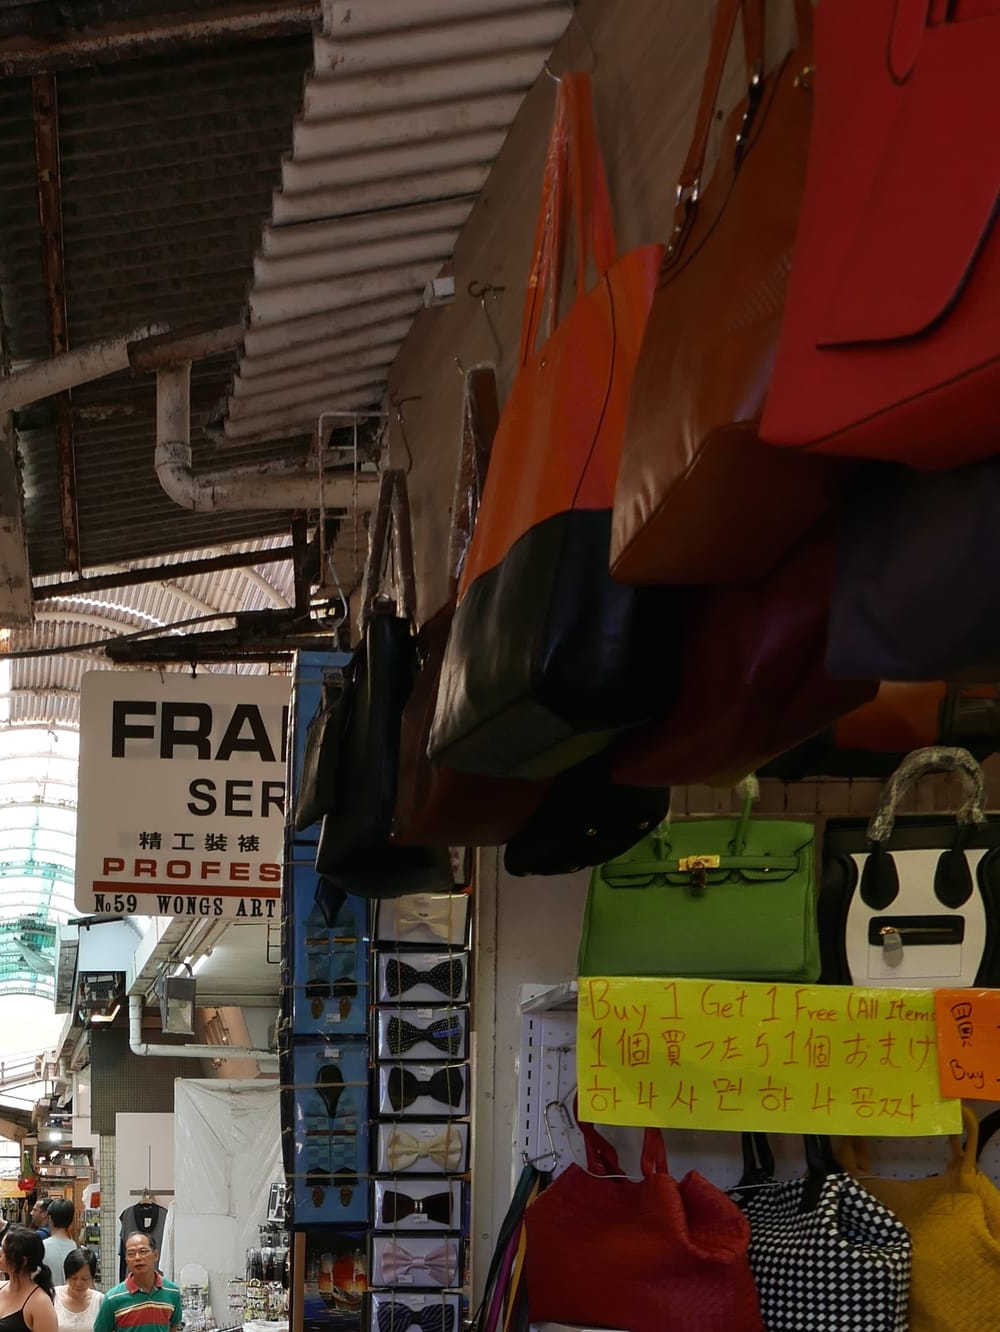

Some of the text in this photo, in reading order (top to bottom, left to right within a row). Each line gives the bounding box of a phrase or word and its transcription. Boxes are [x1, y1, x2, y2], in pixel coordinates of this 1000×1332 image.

[112, 700, 289, 762] FRA
[186, 778, 287, 818] SER
[139, 831, 261, 853] 精工裝裱
[102, 857, 281, 882] PROFES
[157, 896, 224, 917] WONGS
[236, 898, 277, 918] ART
[588, 978, 648, 1032] Buy
[660, 982, 684, 1021] 1
[700, 984, 748, 1020] Get
[762, 986, 782, 1022] 1
[795, 988, 838, 1023] Free
[949, 1058, 985, 1090] Buy
